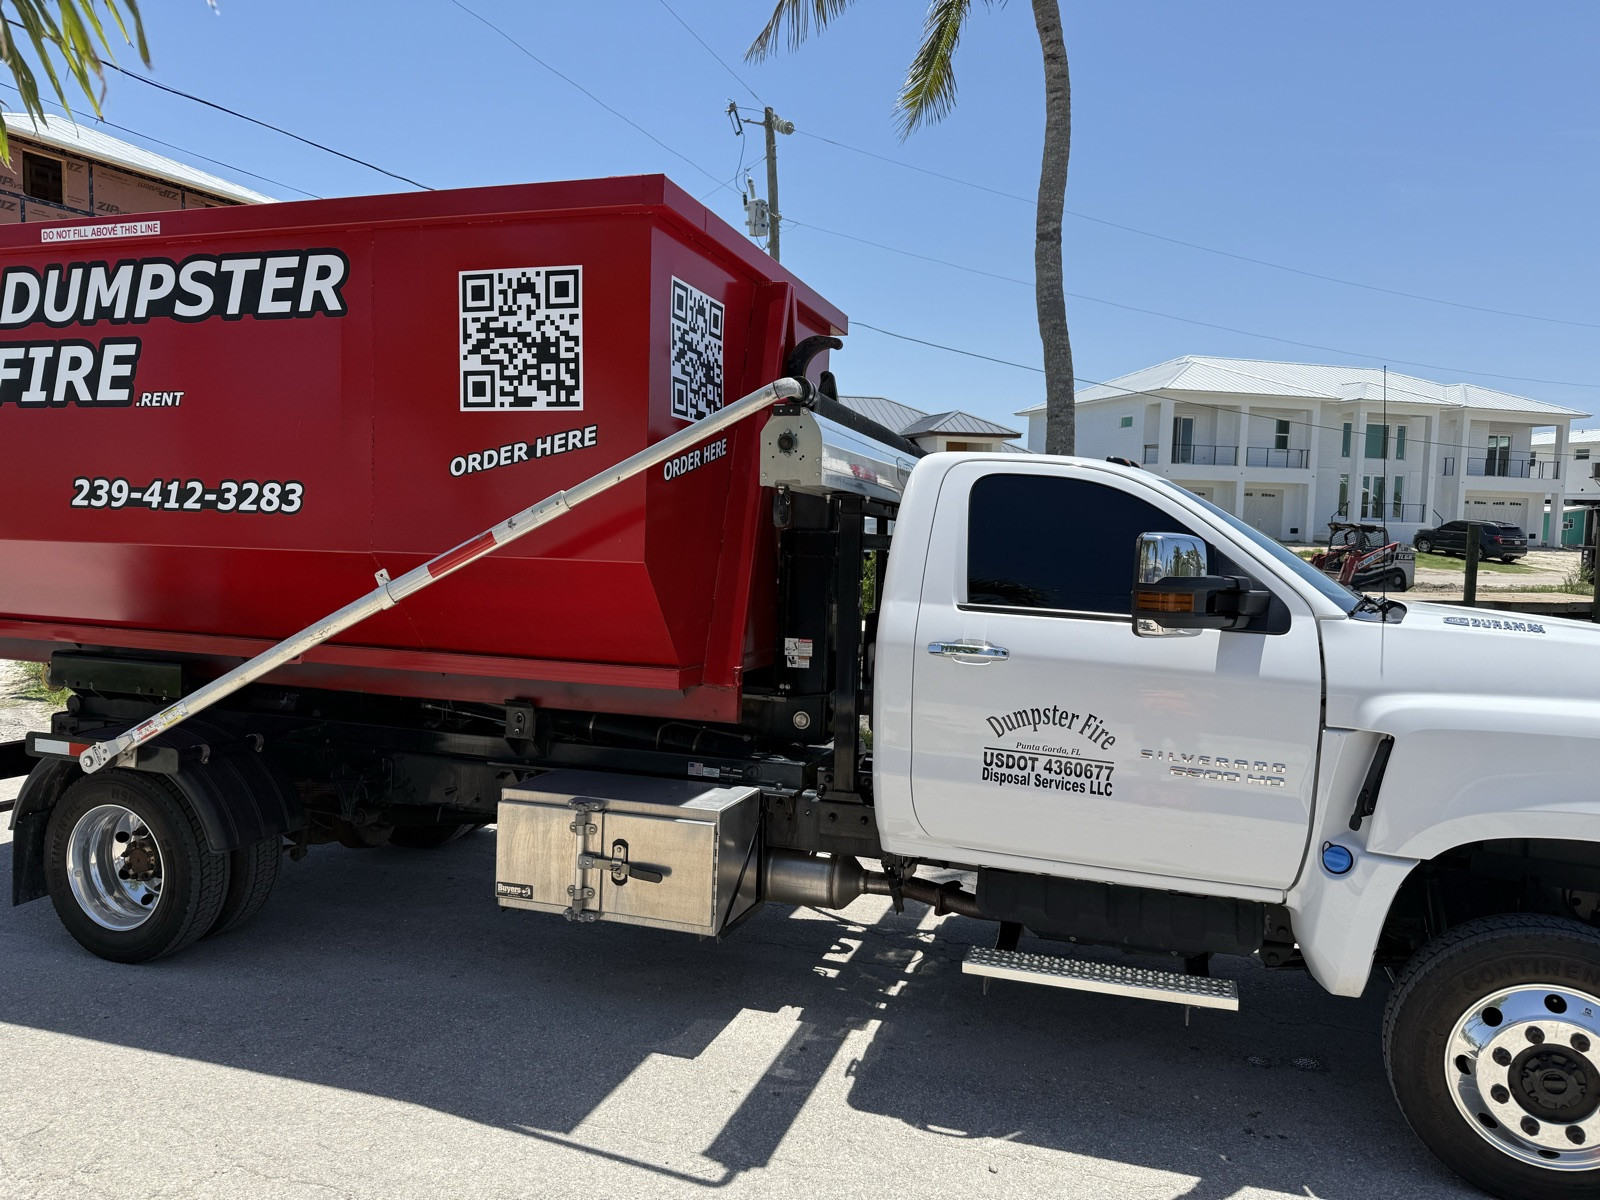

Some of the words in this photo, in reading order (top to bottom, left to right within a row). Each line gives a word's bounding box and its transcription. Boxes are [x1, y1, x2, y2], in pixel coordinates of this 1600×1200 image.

[43, 231, 54, 241] DO
[56, 229, 71, 239] NOT
[73, 228, 88, 238] FILL
[91, 225, 117, 237] ABOVE
[120, 224, 138, 235] THIS
[140, 222, 158, 234] LINE
[0, 253, 346, 325] DUMPSTER
[0, 343, 137, 402] FIRE
[450, 442, 529, 476] ORDER
[536, 425, 597, 457] HERE
[664, 449, 701, 481] ORDER
[703, 438, 727, 465] HERE
[71, 479, 304, 512] 239-412-3283
[986, 705, 1080, 738] Dumpster
[1078, 713, 1116, 750] Fire
[1016, 742, 1040, 751] Punta
[1042, 745, 1069, 755] Gorda,
[1140, 749, 1286, 774] SILVERADO
[982, 767, 1031, 786] Disposal
[1034, 773, 1086, 794] Services
[1089, 780, 1113, 797] LLC
[984, 751, 1039, 772] USDOT
[1043, 759, 1115, 782] 4360677
[1247, 774, 1285, 788] HD
[497, 883, 521, 894] Buyers
